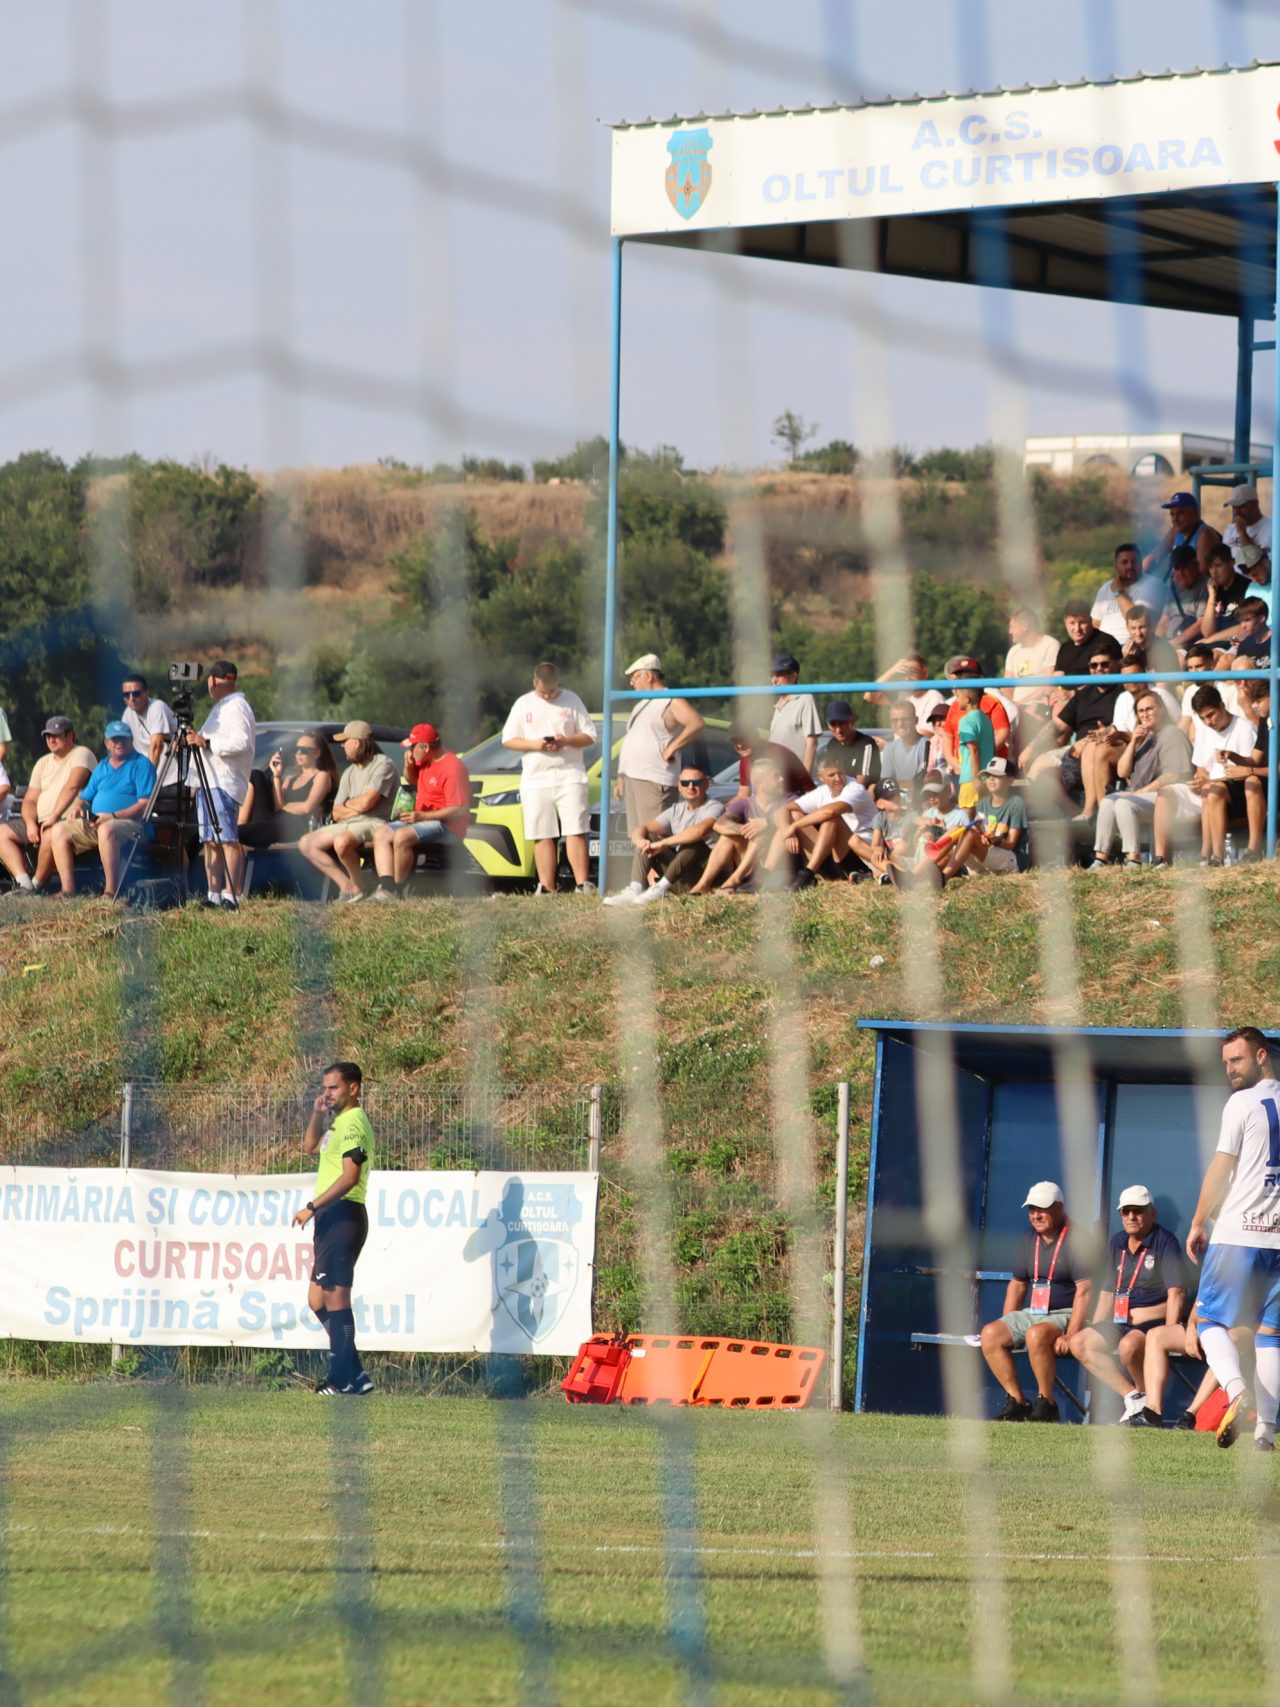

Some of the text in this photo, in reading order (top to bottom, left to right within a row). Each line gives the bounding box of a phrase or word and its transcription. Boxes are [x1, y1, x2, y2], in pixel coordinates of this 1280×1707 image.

[911, 111, 1043, 150] A.C.S.
[761, 136, 1223, 204] OLTUL CURTISOARA
[0, 1176, 135, 1223] RIMĂRIA
[377, 1188, 489, 1229] LOCAL
[520, 1206, 557, 1219] OLTUL
[114, 1239, 316, 1294] CURTIȘOAR
[43, 1285, 416, 1340] Sprijină Spotul
